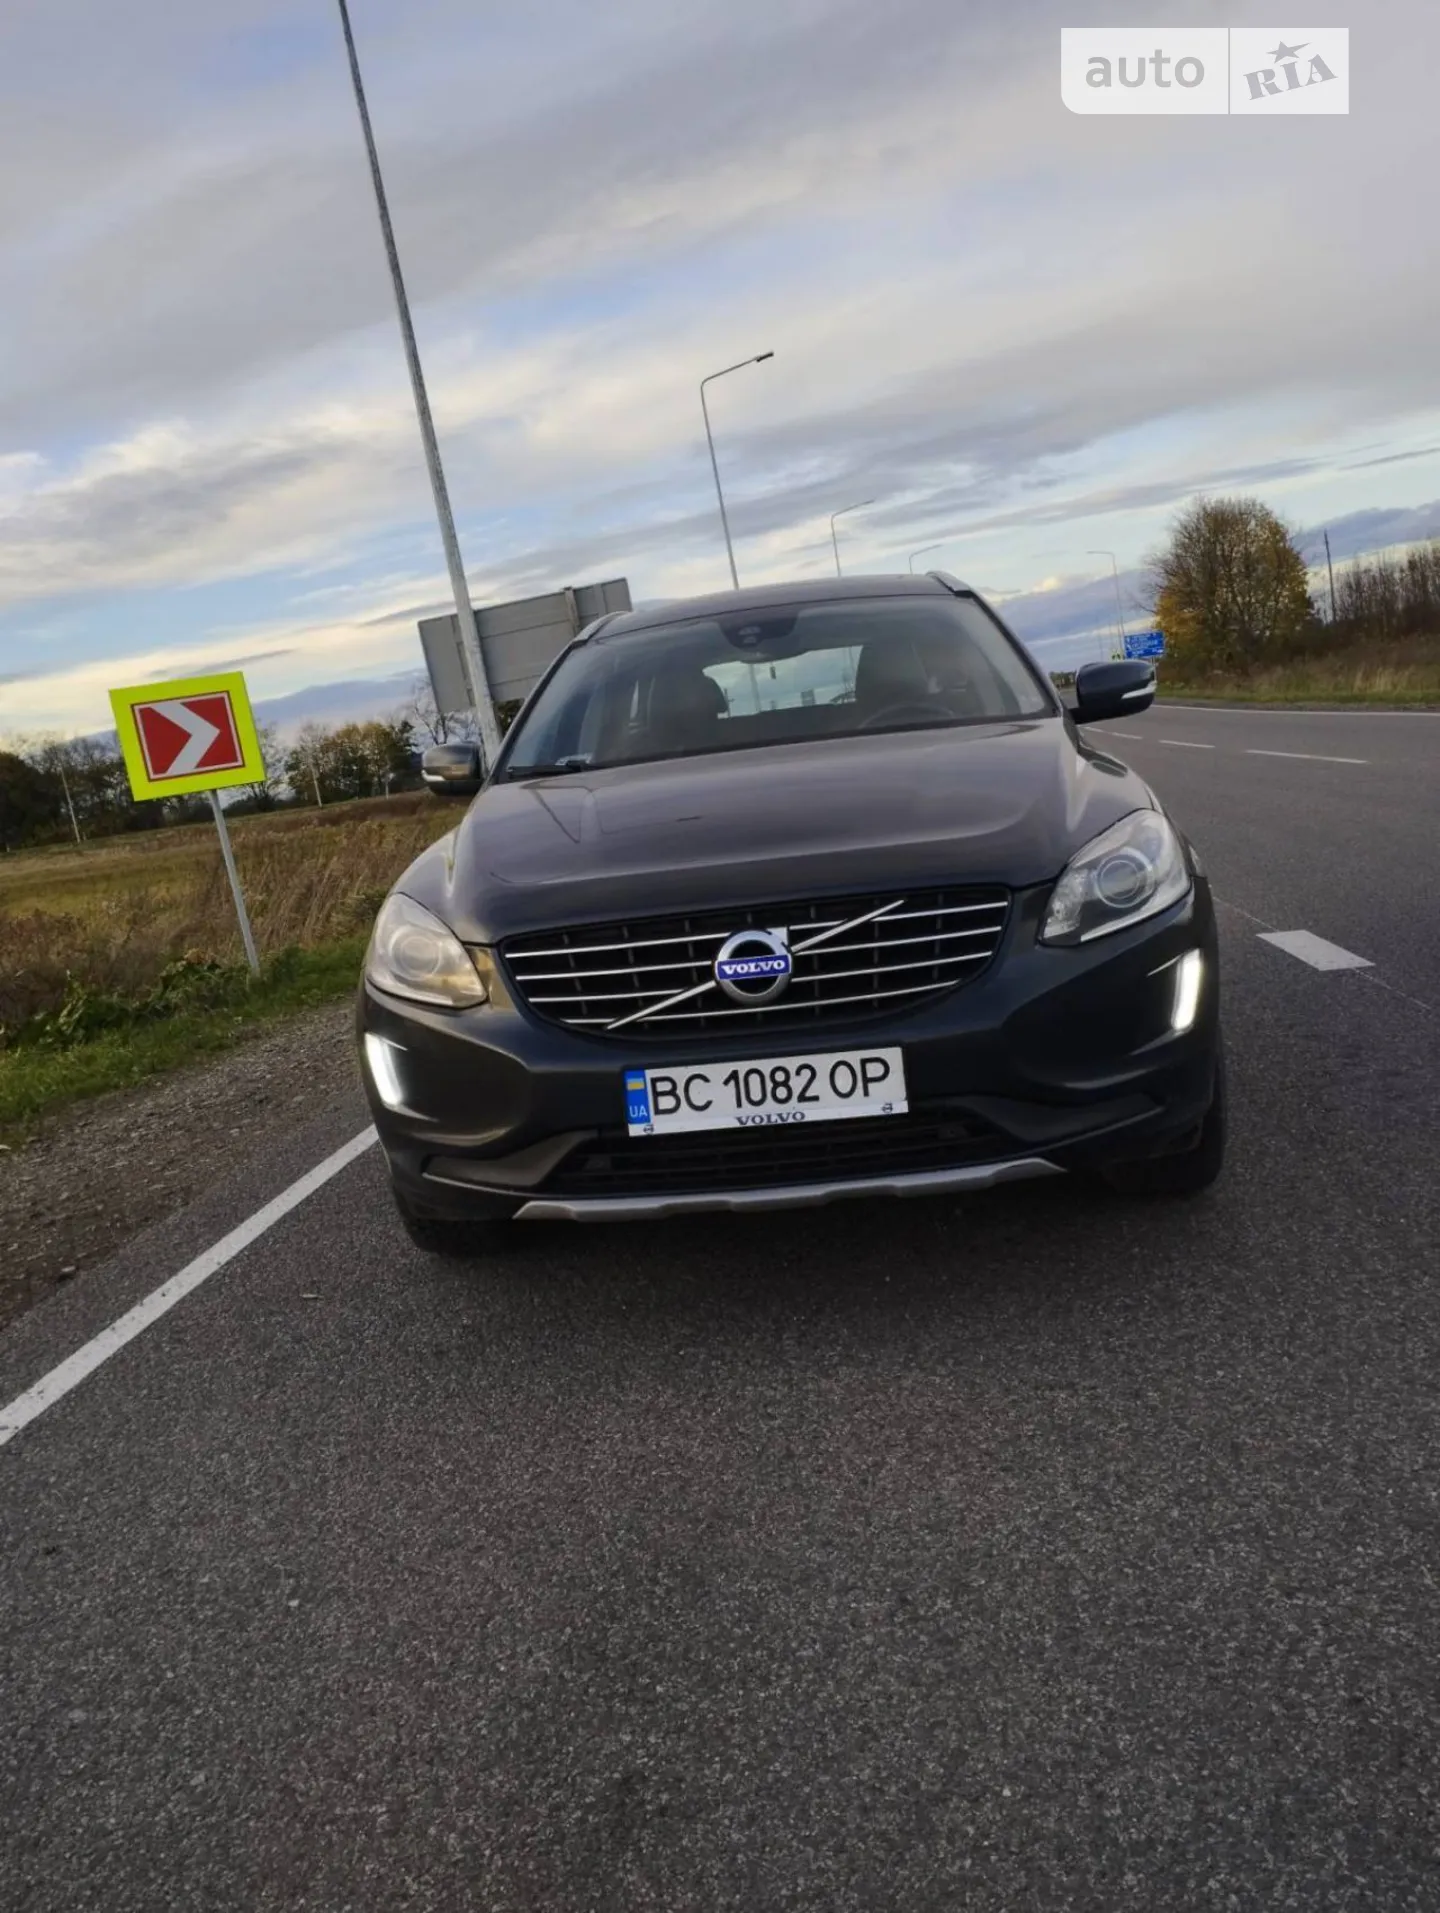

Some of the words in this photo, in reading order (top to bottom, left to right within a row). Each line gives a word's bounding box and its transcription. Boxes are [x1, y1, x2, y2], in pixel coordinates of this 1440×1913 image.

[721, 959, 786, 975] VOLVO
[649, 1073, 713, 1116] BC
[722, 1063, 821, 1109] 1082
[829, 1056, 891, 1099] OP
[629, 1105, 648, 1118] UA
[735, 1111, 806, 1127] VOLVO
